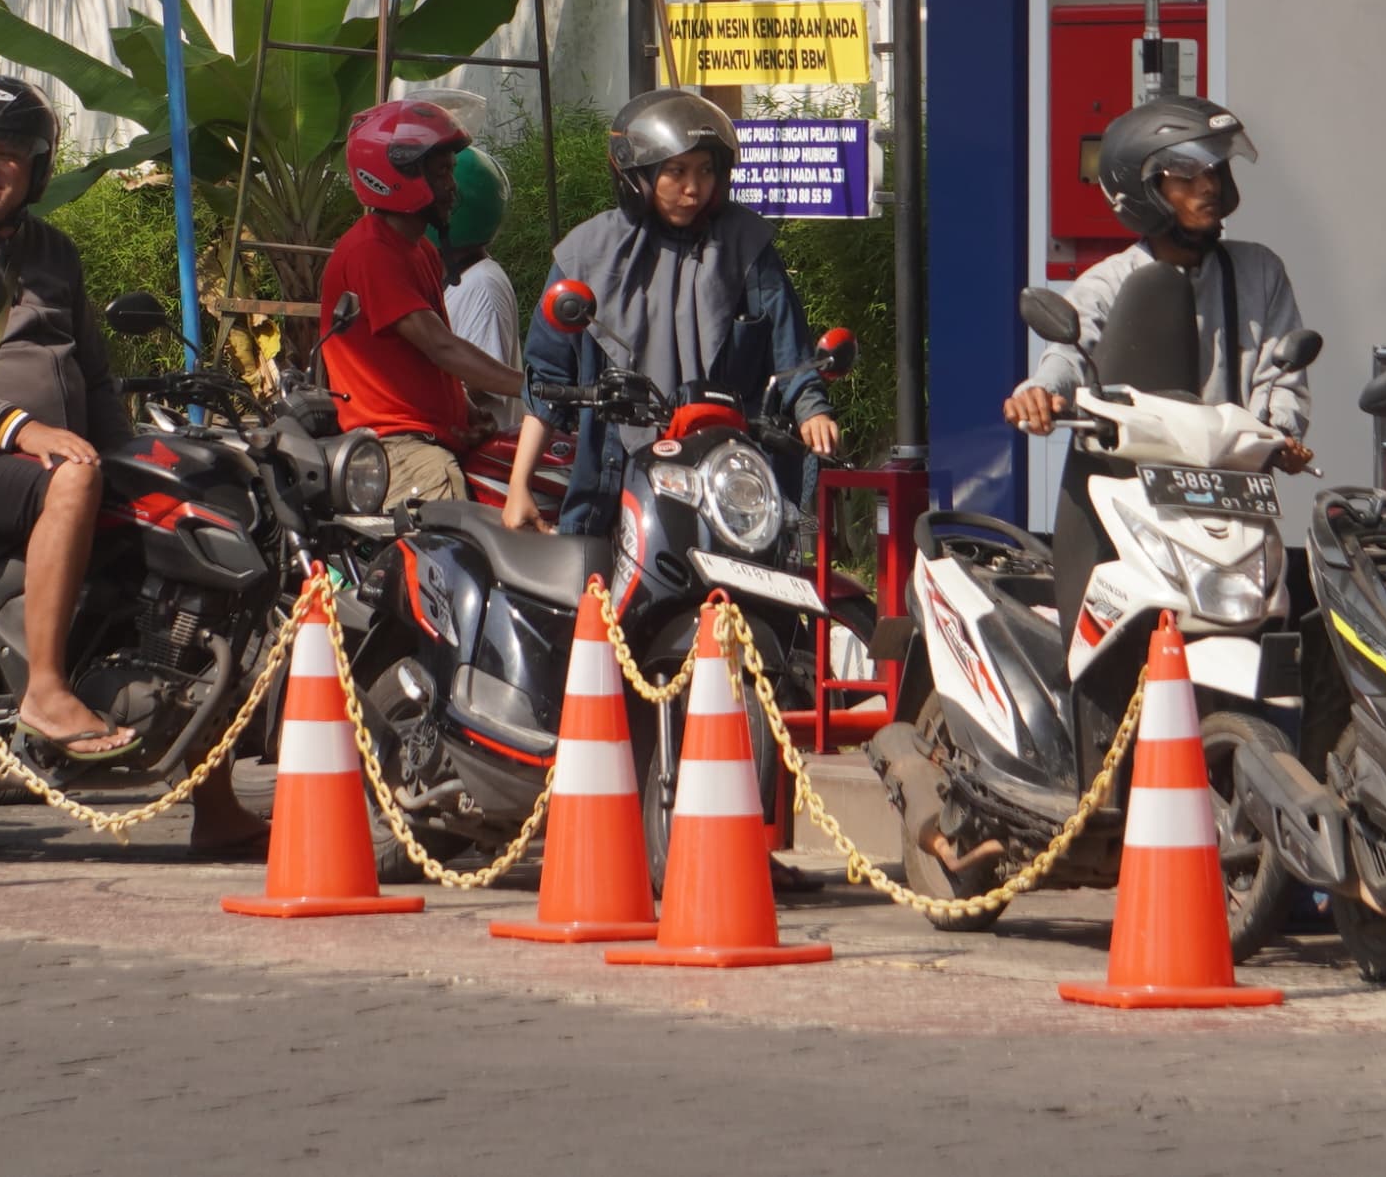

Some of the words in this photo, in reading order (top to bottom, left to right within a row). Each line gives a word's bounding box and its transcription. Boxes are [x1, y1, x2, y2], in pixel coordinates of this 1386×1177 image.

[717, 18, 749, 39] MESIN
[753, 18, 823, 39] KENDARAAN
[825, 18, 858, 39] ANDA
[698, 49, 751, 71] SEWAKTU
[754, 49, 799, 70] MENGISI
[802, 49, 827, 70] BBM
[753, 127, 775, 143] PUAS
[775, 127, 809, 143] DENGAN
[809, 127, 857, 143] PELAYANAN
[771, 147, 800, 163] HARAP
[762, 167, 791, 184] GAJAH
[790, 167, 818, 184] MADA
[1142, 469, 1157, 486] P
[1172, 470, 1225, 492] 5862
[1245, 476, 1273, 497] HF
